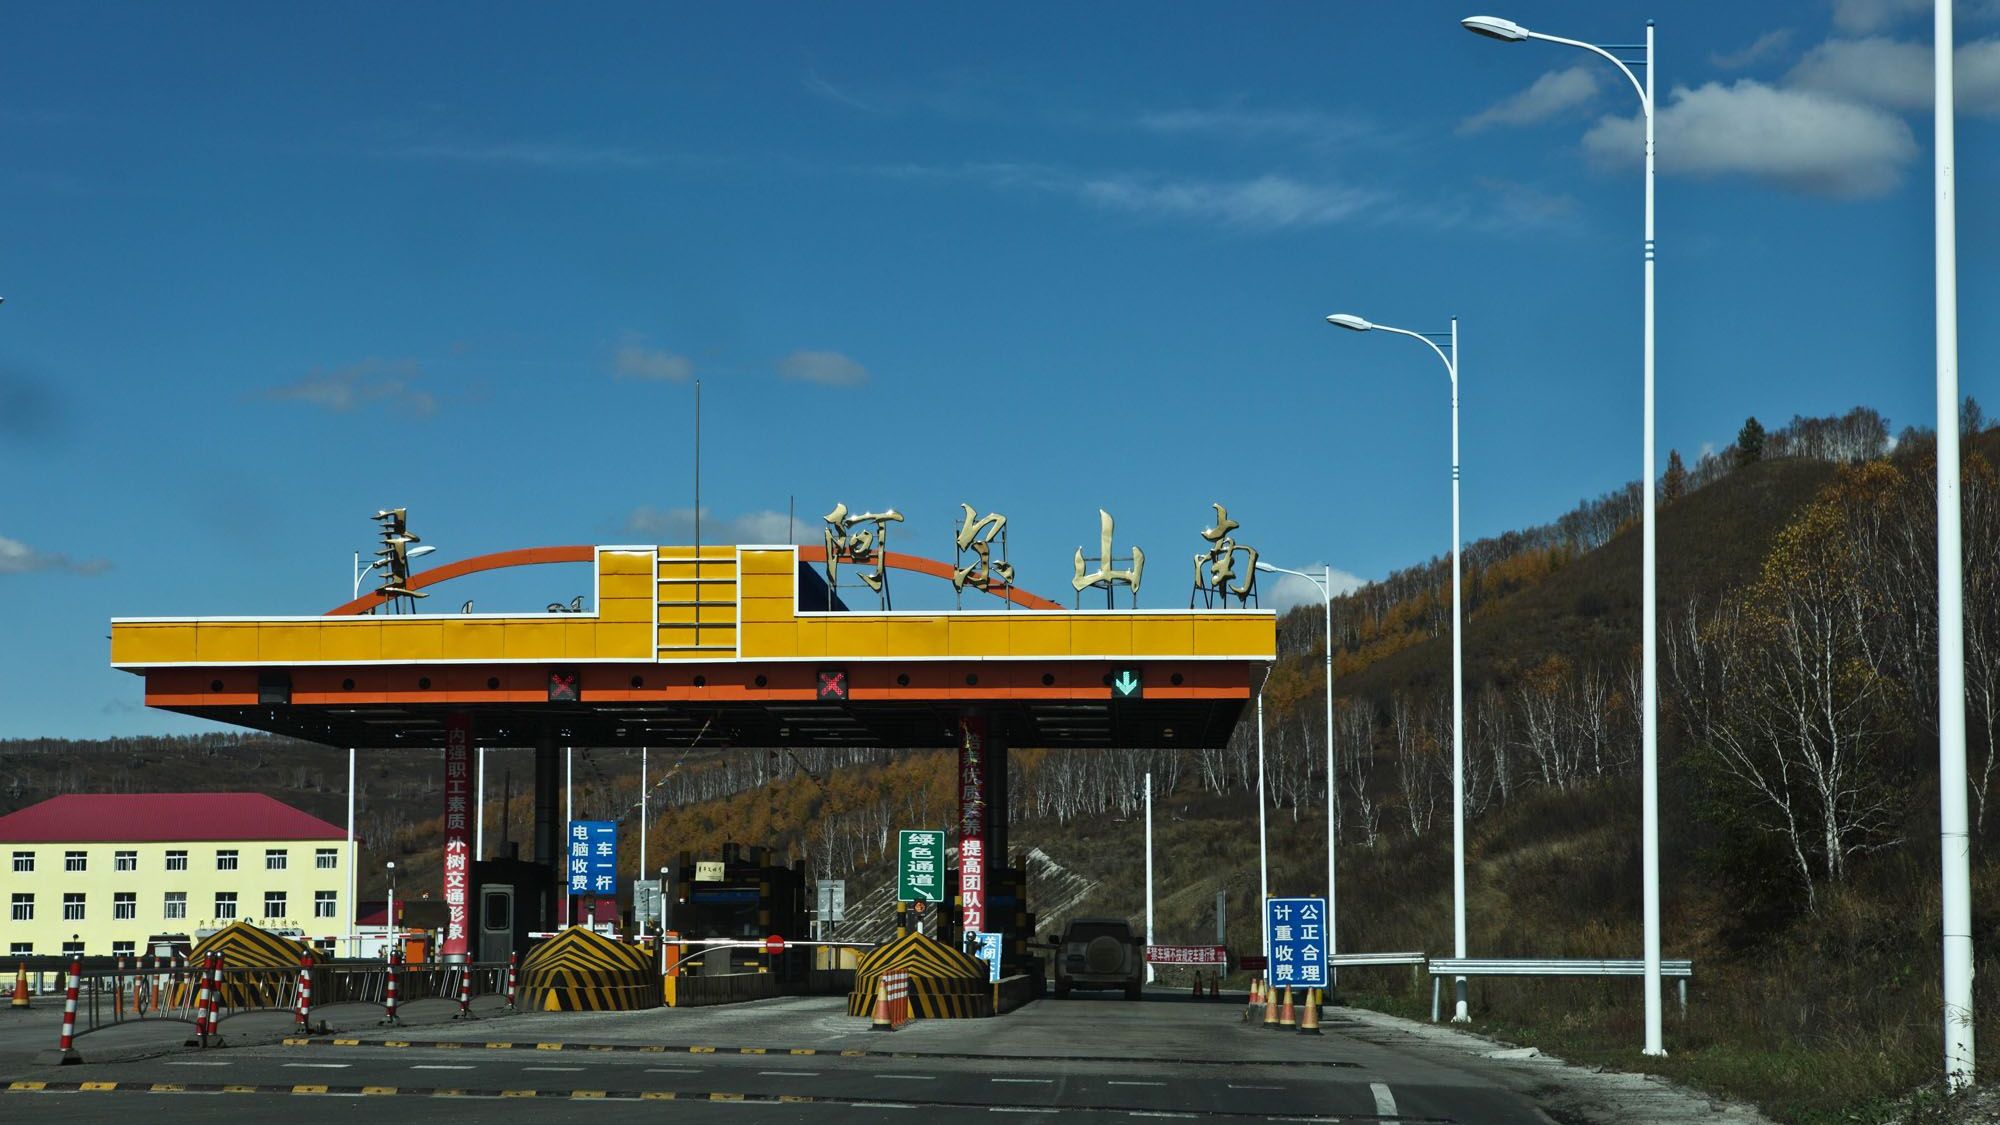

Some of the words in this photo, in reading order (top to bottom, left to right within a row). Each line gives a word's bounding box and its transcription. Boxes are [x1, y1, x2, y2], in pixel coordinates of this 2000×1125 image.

[447, 729, 466, 830] 内强职工素质
[446, 836, 465, 940] 外树交通形象
[572, 824, 589, 891] 电脑收费
[596, 828, 613, 891] 一车一杆
[907, 833, 935, 886] 绿色通道
[1274, 904, 1293, 981] 计重收费
[1300, 904, 1320, 981] 公正合理
